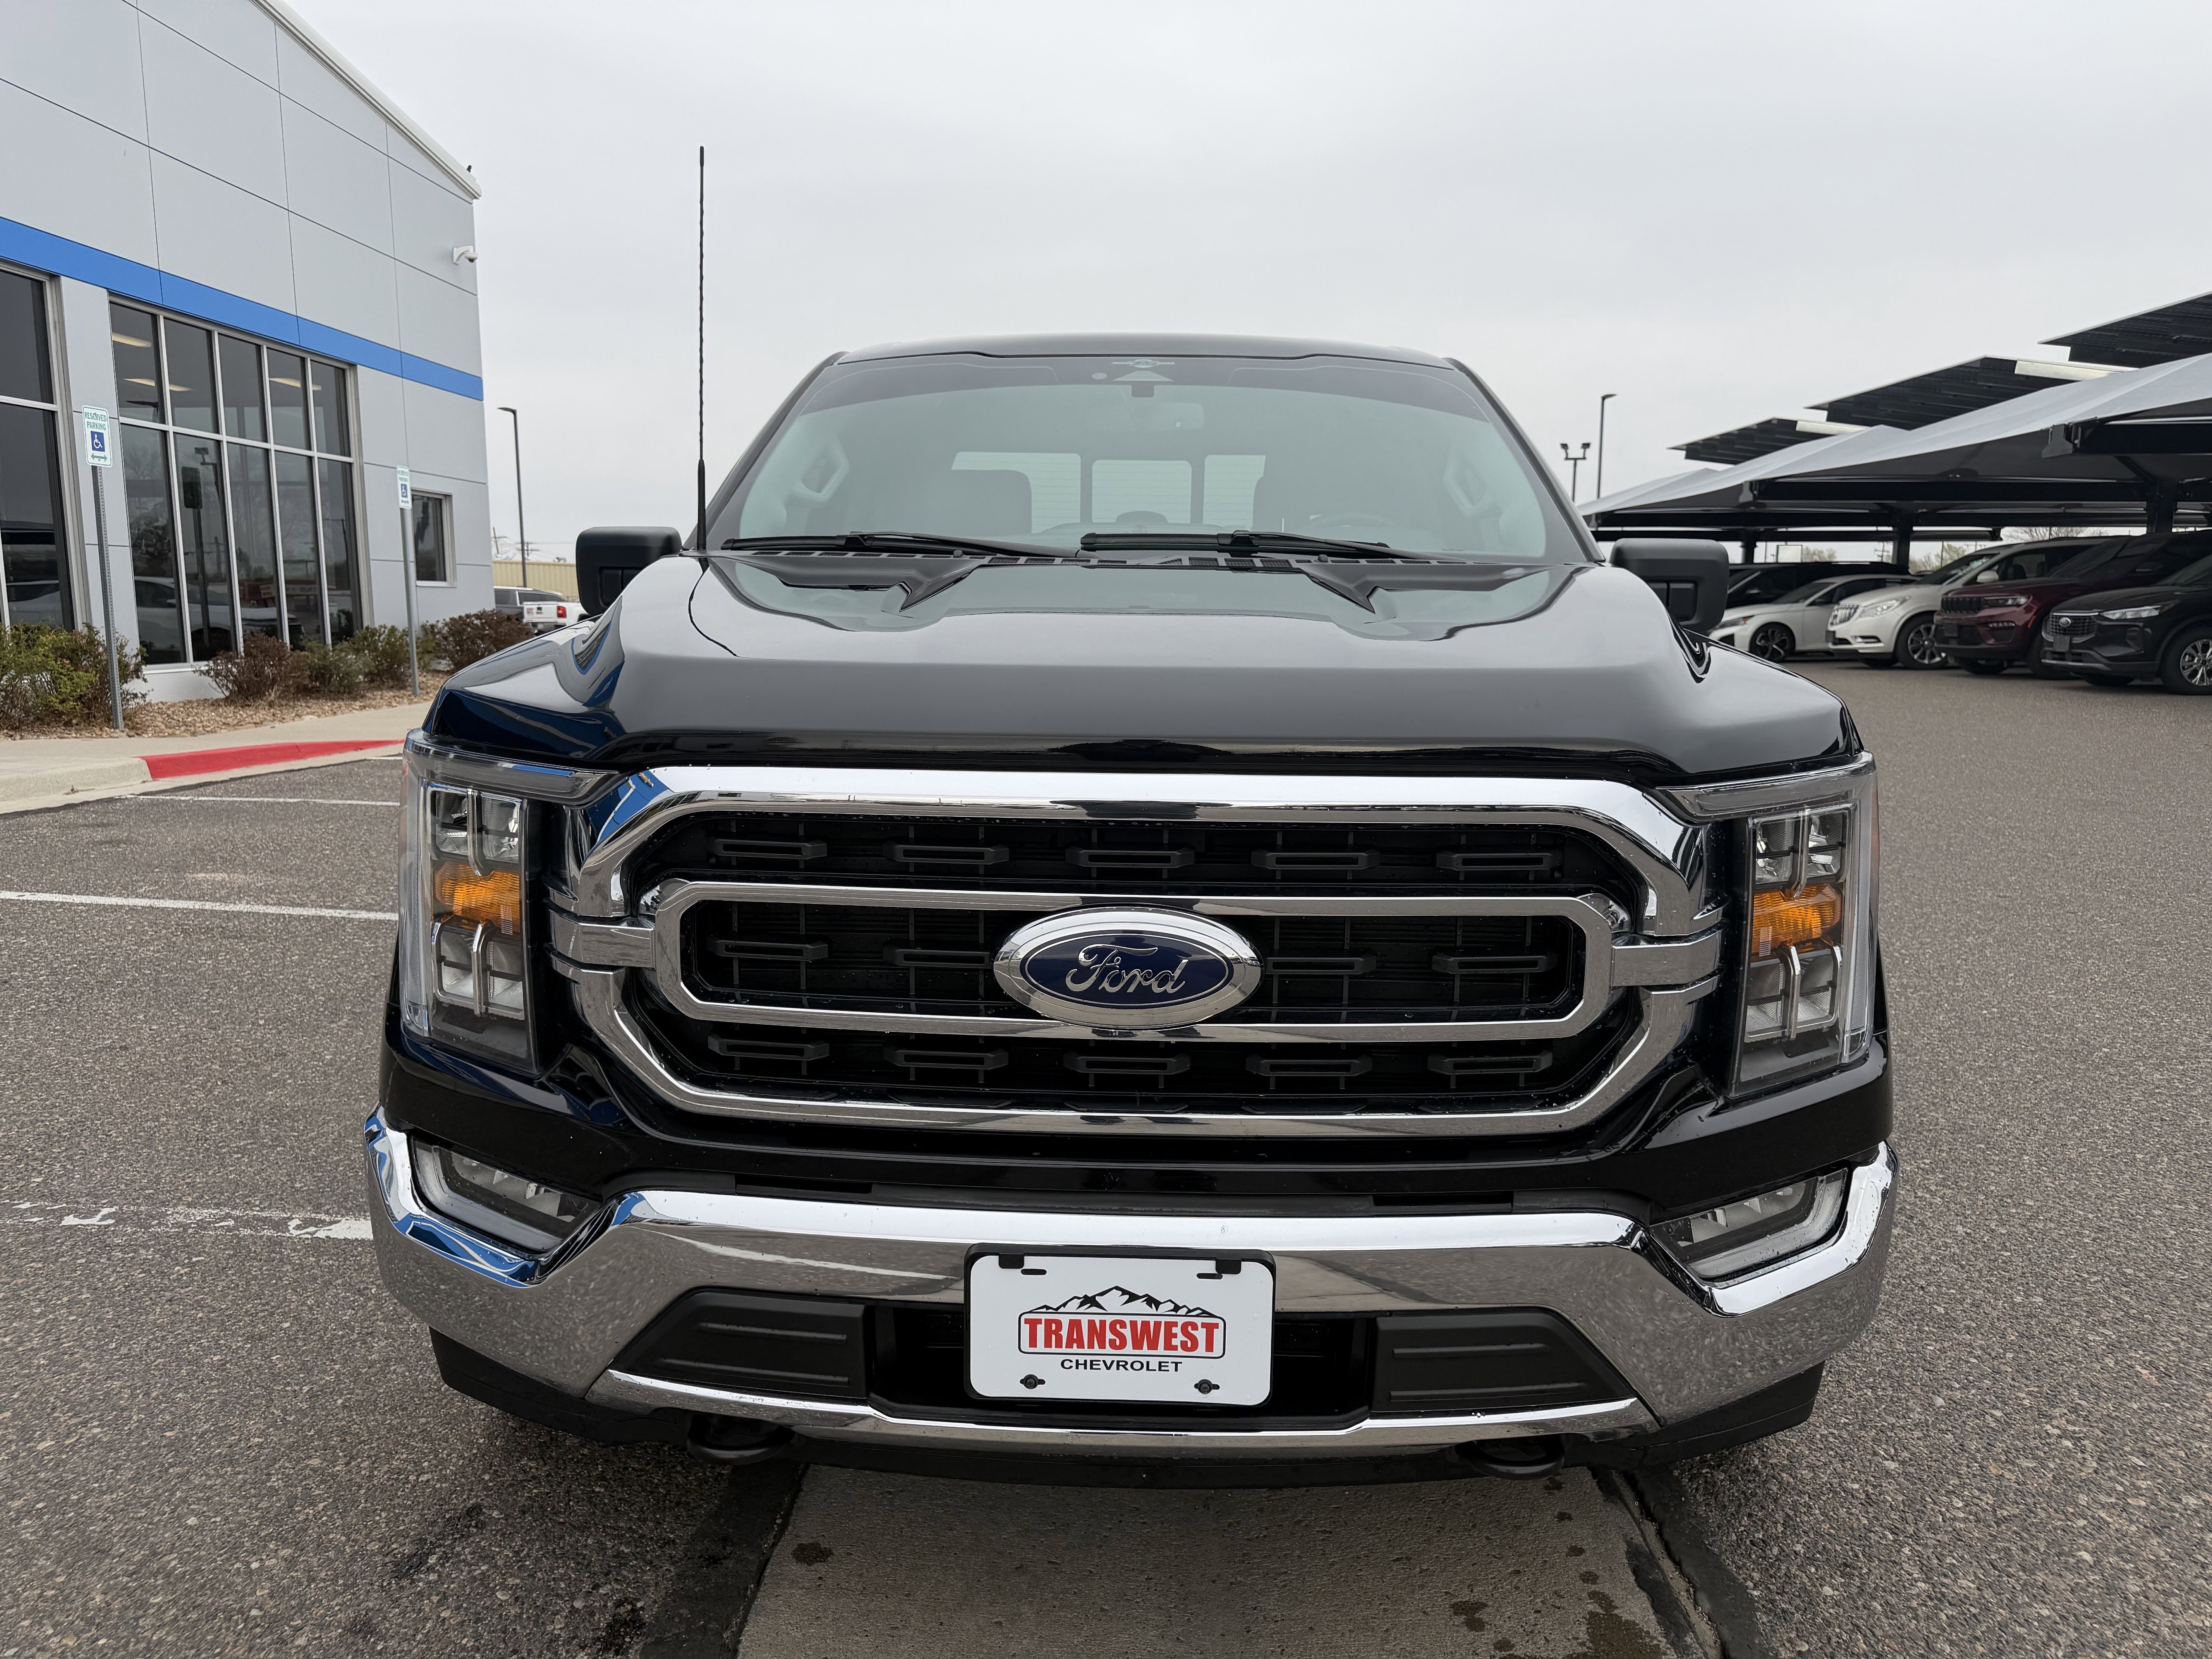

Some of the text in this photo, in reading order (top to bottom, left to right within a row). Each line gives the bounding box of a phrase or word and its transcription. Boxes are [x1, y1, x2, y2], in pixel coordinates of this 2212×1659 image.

[84, 412, 106, 422] RESERVED
[87, 421, 106, 431] PARKING
[1065, 944, 1189, 993] Ford
[1024, 1318, 1219, 1353] TRANSWEST
[1060, 1358, 1183, 1372] CHEVROLET
